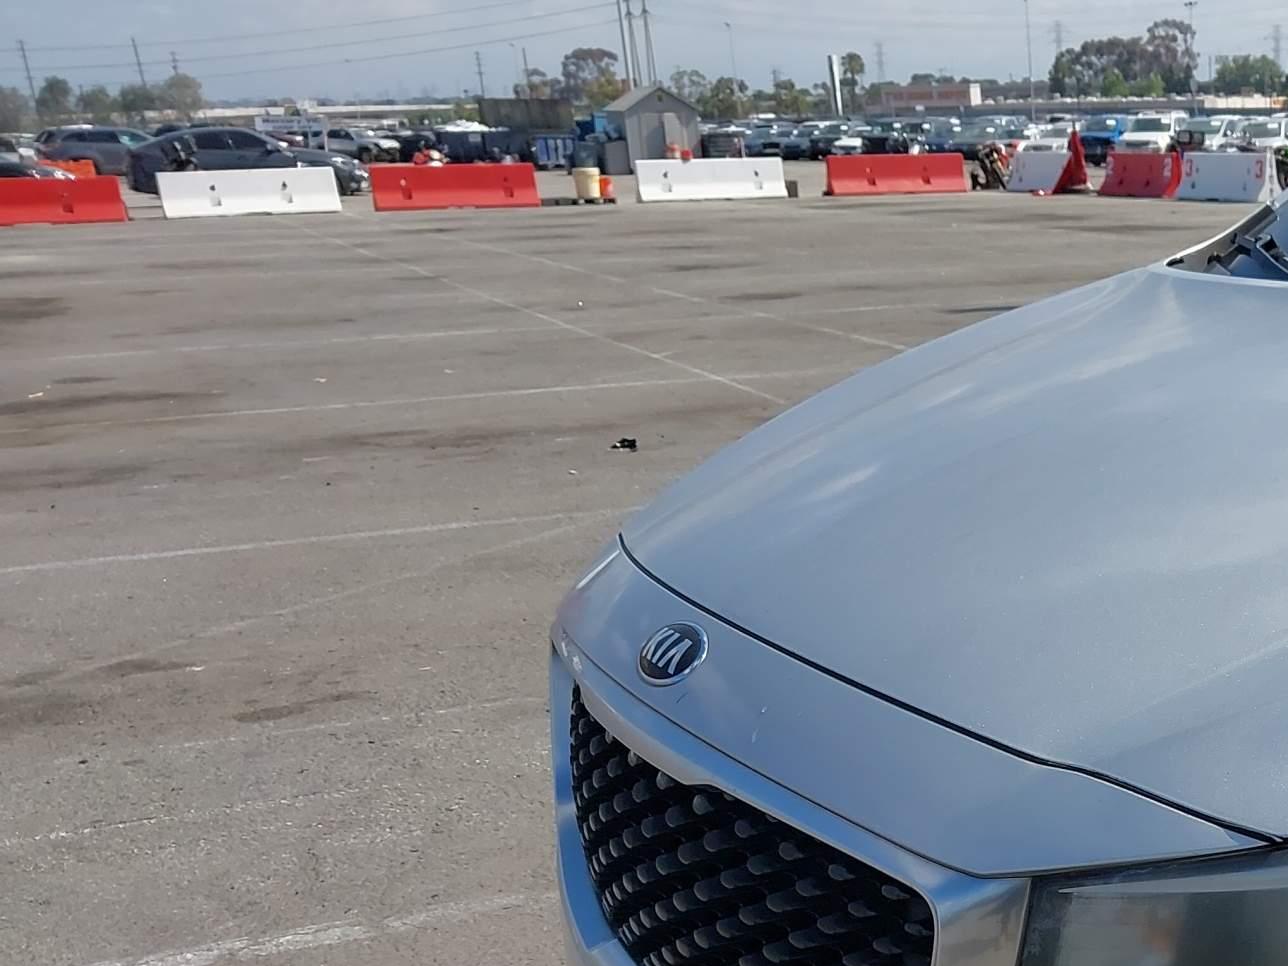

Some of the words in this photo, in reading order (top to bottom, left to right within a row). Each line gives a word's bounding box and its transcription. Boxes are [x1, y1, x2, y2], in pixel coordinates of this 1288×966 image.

[1163, 157, 1172, 177] 2
[1185, 159, 1193, 177] 3
[1255, 159, 1264, 179] 3
[641, 627, 693, 676] KIA
